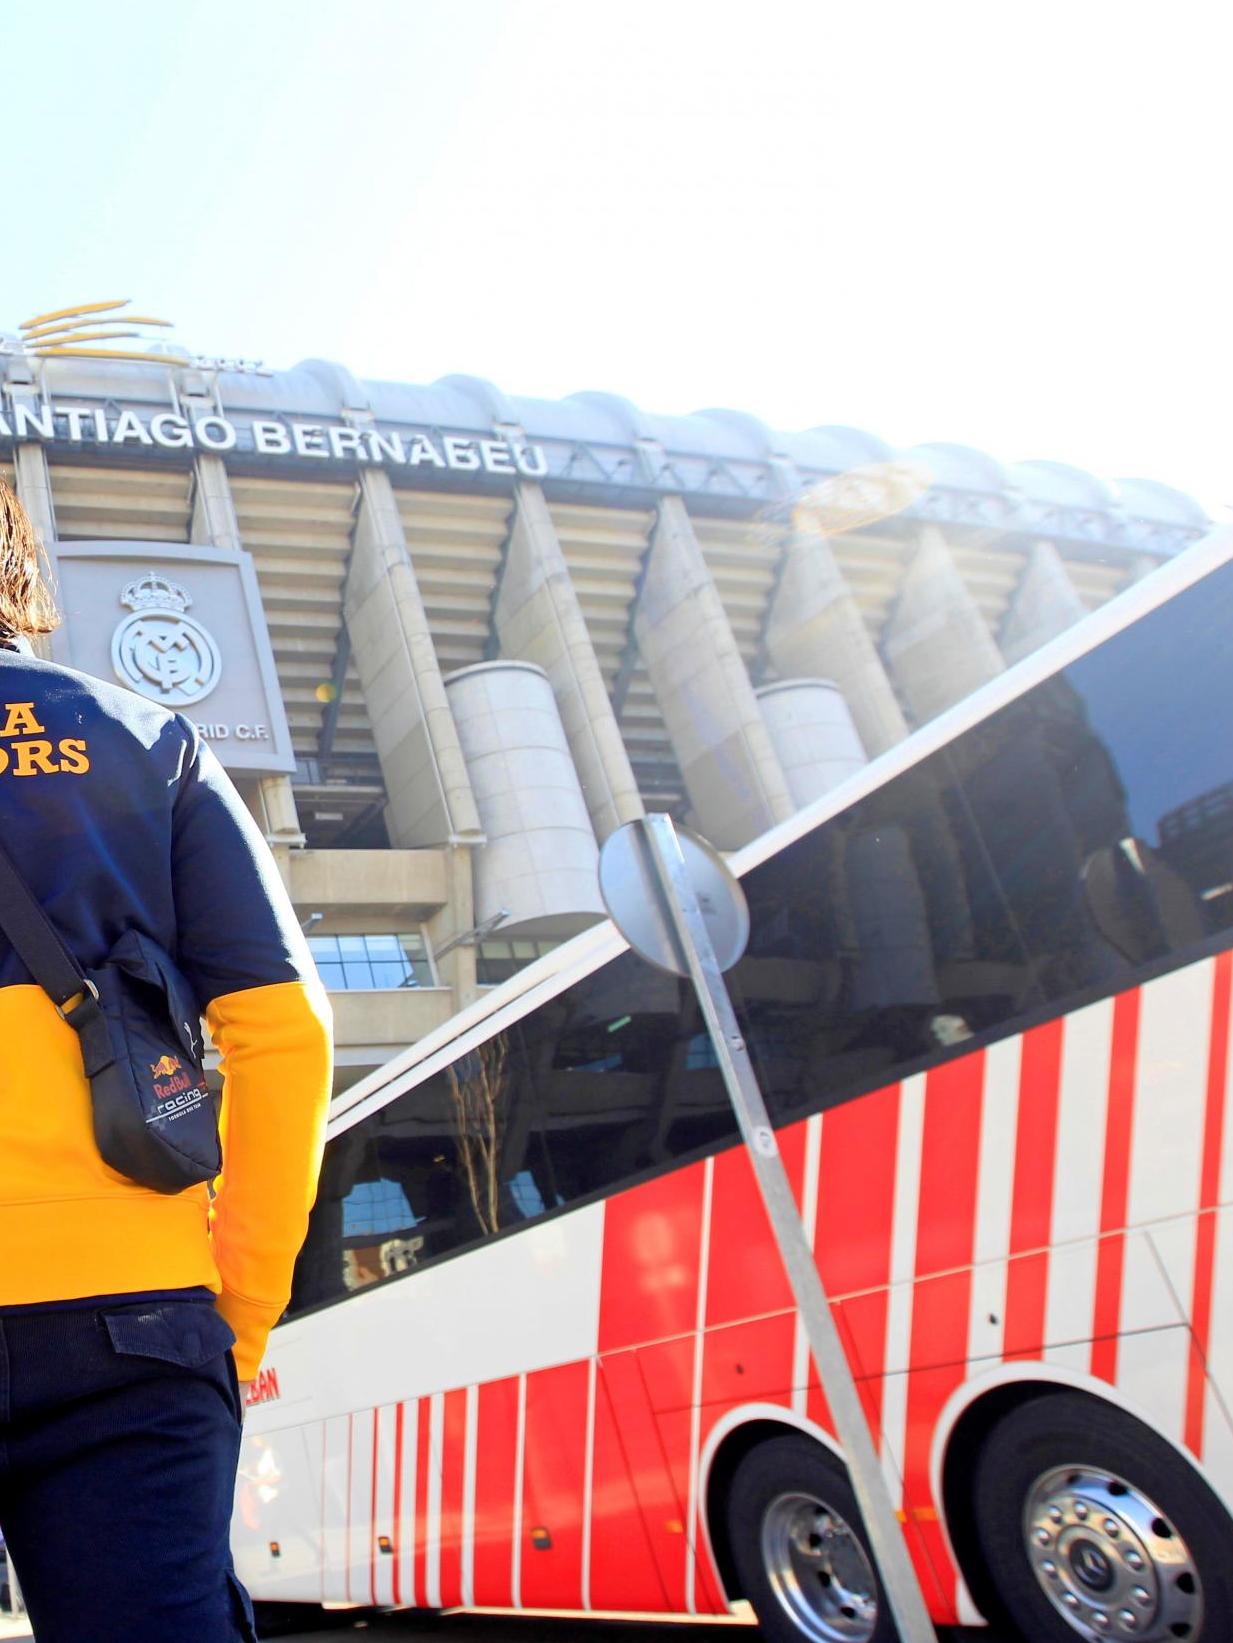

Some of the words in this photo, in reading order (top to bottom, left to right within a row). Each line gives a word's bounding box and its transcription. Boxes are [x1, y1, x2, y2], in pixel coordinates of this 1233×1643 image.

[252, 420, 549, 476] BERNABEU
[198, 722, 229, 739] RID
[235, 723, 269, 740] C.F.
[158, 1088, 202, 1114] racing
